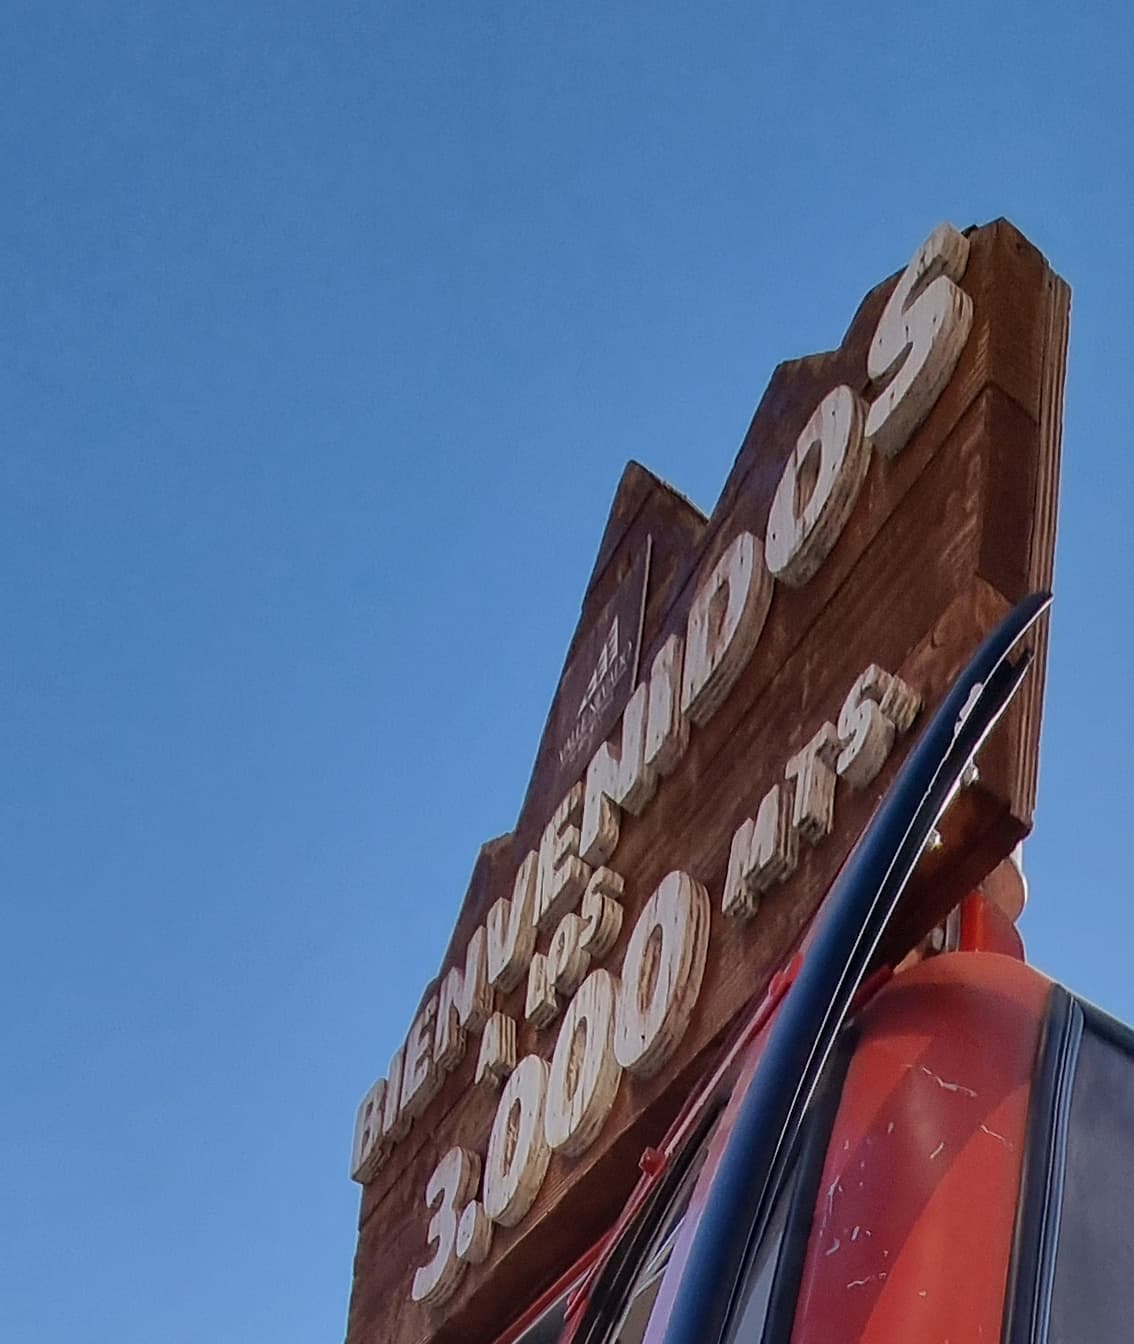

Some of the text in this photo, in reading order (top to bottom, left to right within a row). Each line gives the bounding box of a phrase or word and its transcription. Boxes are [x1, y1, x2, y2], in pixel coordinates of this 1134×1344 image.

[351, 222, 974, 1184] BIENVENIDOS
[411, 662, 922, 1304] 3.000 MTS
[473, 865, 625, 1088] A LOS
